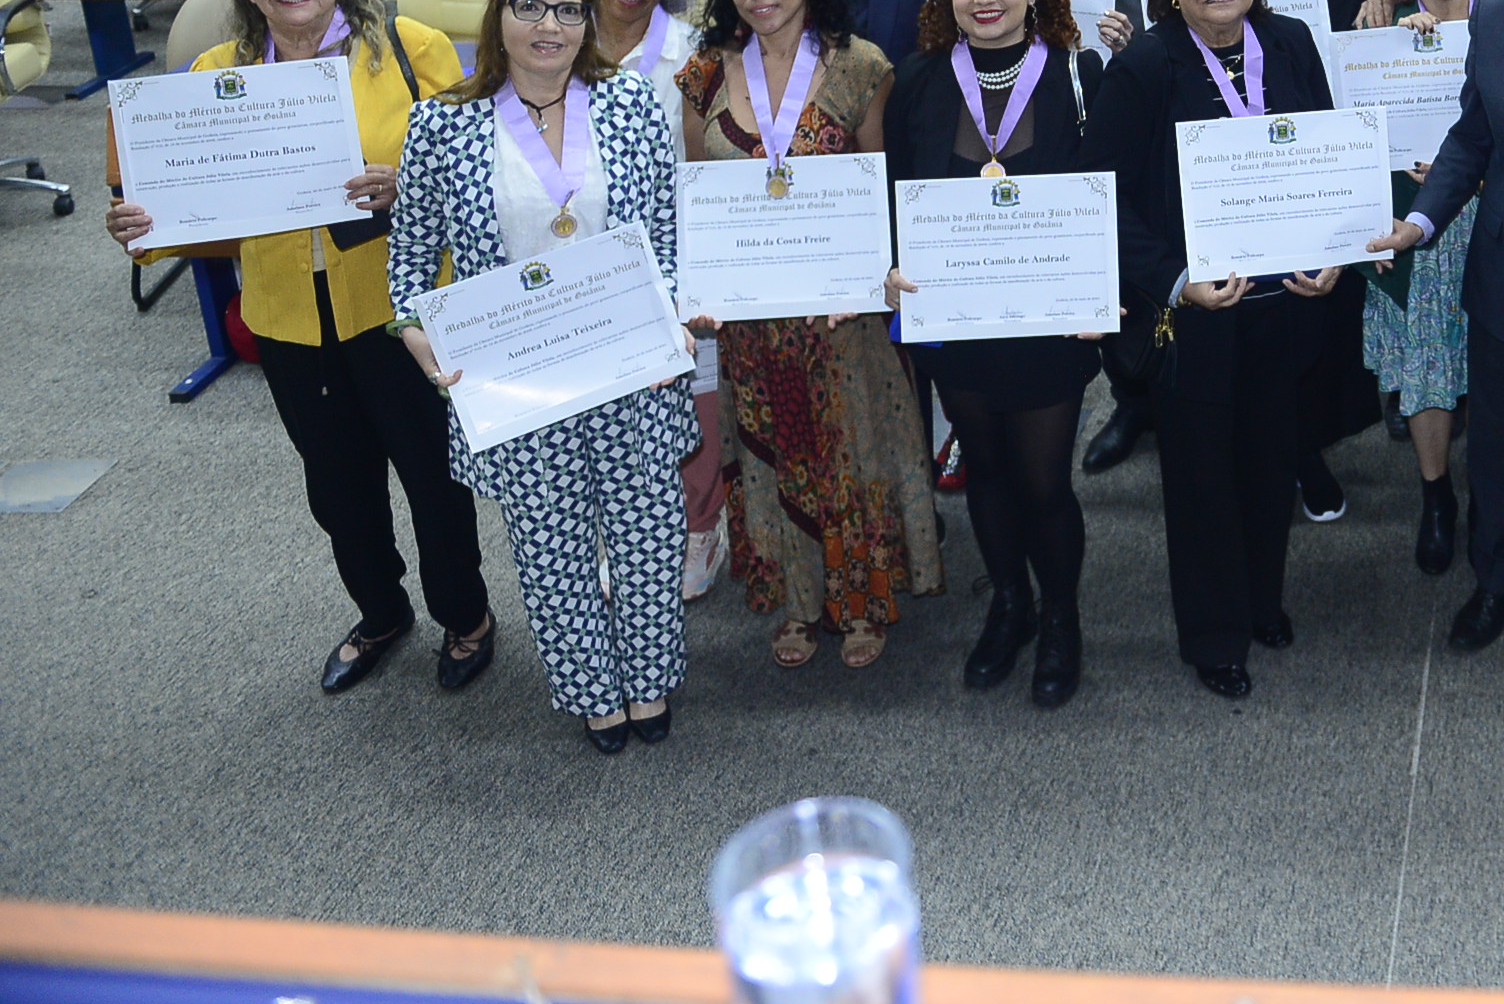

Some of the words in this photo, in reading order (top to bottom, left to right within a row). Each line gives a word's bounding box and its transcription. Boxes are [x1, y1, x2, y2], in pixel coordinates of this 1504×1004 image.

[1344, 61, 1379, 73] Medalha
[1392, 58, 1420, 69] Mérito
[1421, 58, 1431, 66] da
[1433, 56, 1464, 65] Cultura
[1382, 72, 1408, 80] Câmara
[1409, 69, 1442, 79] Municipal
[131, 111, 173, 125] Medalha
[174, 110, 187, 119] do
[188, 106, 222, 119] Mérito
[223, 104, 236, 114] da
[237, 101, 276, 113] Cultura
[277, 97, 305, 110] Júlio
[307, 93, 337, 105] Vilela
[1352, 99, 1376, 108] Maria
[1377, 97, 1415, 107] Aparecida
[1416, 95, 1442, 104] Batista
[173, 120, 207, 131] Câmara
[208, 114, 251, 128] Municipal
[251, 114, 262, 122] de
[263, 110, 297, 121] Goiânia
[165, 157, 195, 168] Maria
[197, 155, 210, 165] de
[212, 152, 248, 163] Fátima
[249, 149, 280, 159] Dutra
[282, 145, 316, 156] Bastos
[1193, 153, 1230, 166] Medalha
[1231, 153, 1242, 162] do
[1243, 149, 1274, 161] Mérito
[1274, 148, 1286, 157] da
[1287, 146, 1321, 157] Cultura
[1322, 143, 1346, 155] Júlio
[1348, 140, 1374, 151] Vilela
[1230, 162, 1260, 172] Câmara
[1261, 158, 1299, 170] Municipal
[1299, 158, 1308, 166] de
[1309, 155, 1339, 165] Goiânia
[690, 195, 728, 207] Medalha
[729, 195, 740, 204] do
[820, 188, 844, 200] Júlio
[845, 187, 872, 197] Vilela
[1220, 197, 1256, 207] Solange
[1258, 193, 1285, 204] Maria
[1286, 192, 1316, 201] Soares
[1317, 187, 1353, 199] Ferreira
[911, 214, 951, 225] Medalha
[952, 214, 963, 223] do
[964, 211, 997, 223] Mérito
[997, 211, 1009, 220] da
[1010, 210, 1045, 220] Cultura
[1047, 208, 1072, 220] Júlio
[1073, 206, 1100, 217] Vilela
[950, 224, 981, 234] Câmara
[982, 221, 1022, 233] Municipal
[1022, 221, 1031, 230] de
[1032, 220, 1063, 229] Goiânia
[735, 238, 761, 248] Hilda
[762, 237, 774, 246] da
[775, 237, 802, 246] Costa
[804, 235, 831, 244] Freire
[945, 259, 981, 270] Laryssa
[982, 256, 1016, 266] Camilo
[1017, 255, 1030, 264] de
[1031, 253, 1071, 264] Andrade
[444, 315, 486, 336] Medalha
[486, 310, 499, 320] do
[500, 298, 534, 317] Mérito
[533, 293, 547, 303] da
[547, 280, 585, 298] Cultura
[585, 270, 612, 286] Júlio
[612, 260, 641, 275] Vilela
[488, 314, 521, 330] Câmara
[522, 298, 563, 320] Municipal
[562, 296, 573, 304] de
[574, 284, 606, 300] Goiânia
[507, 343, 542, 361] Andrea
[570, 318, 613, 337] Teixeira
